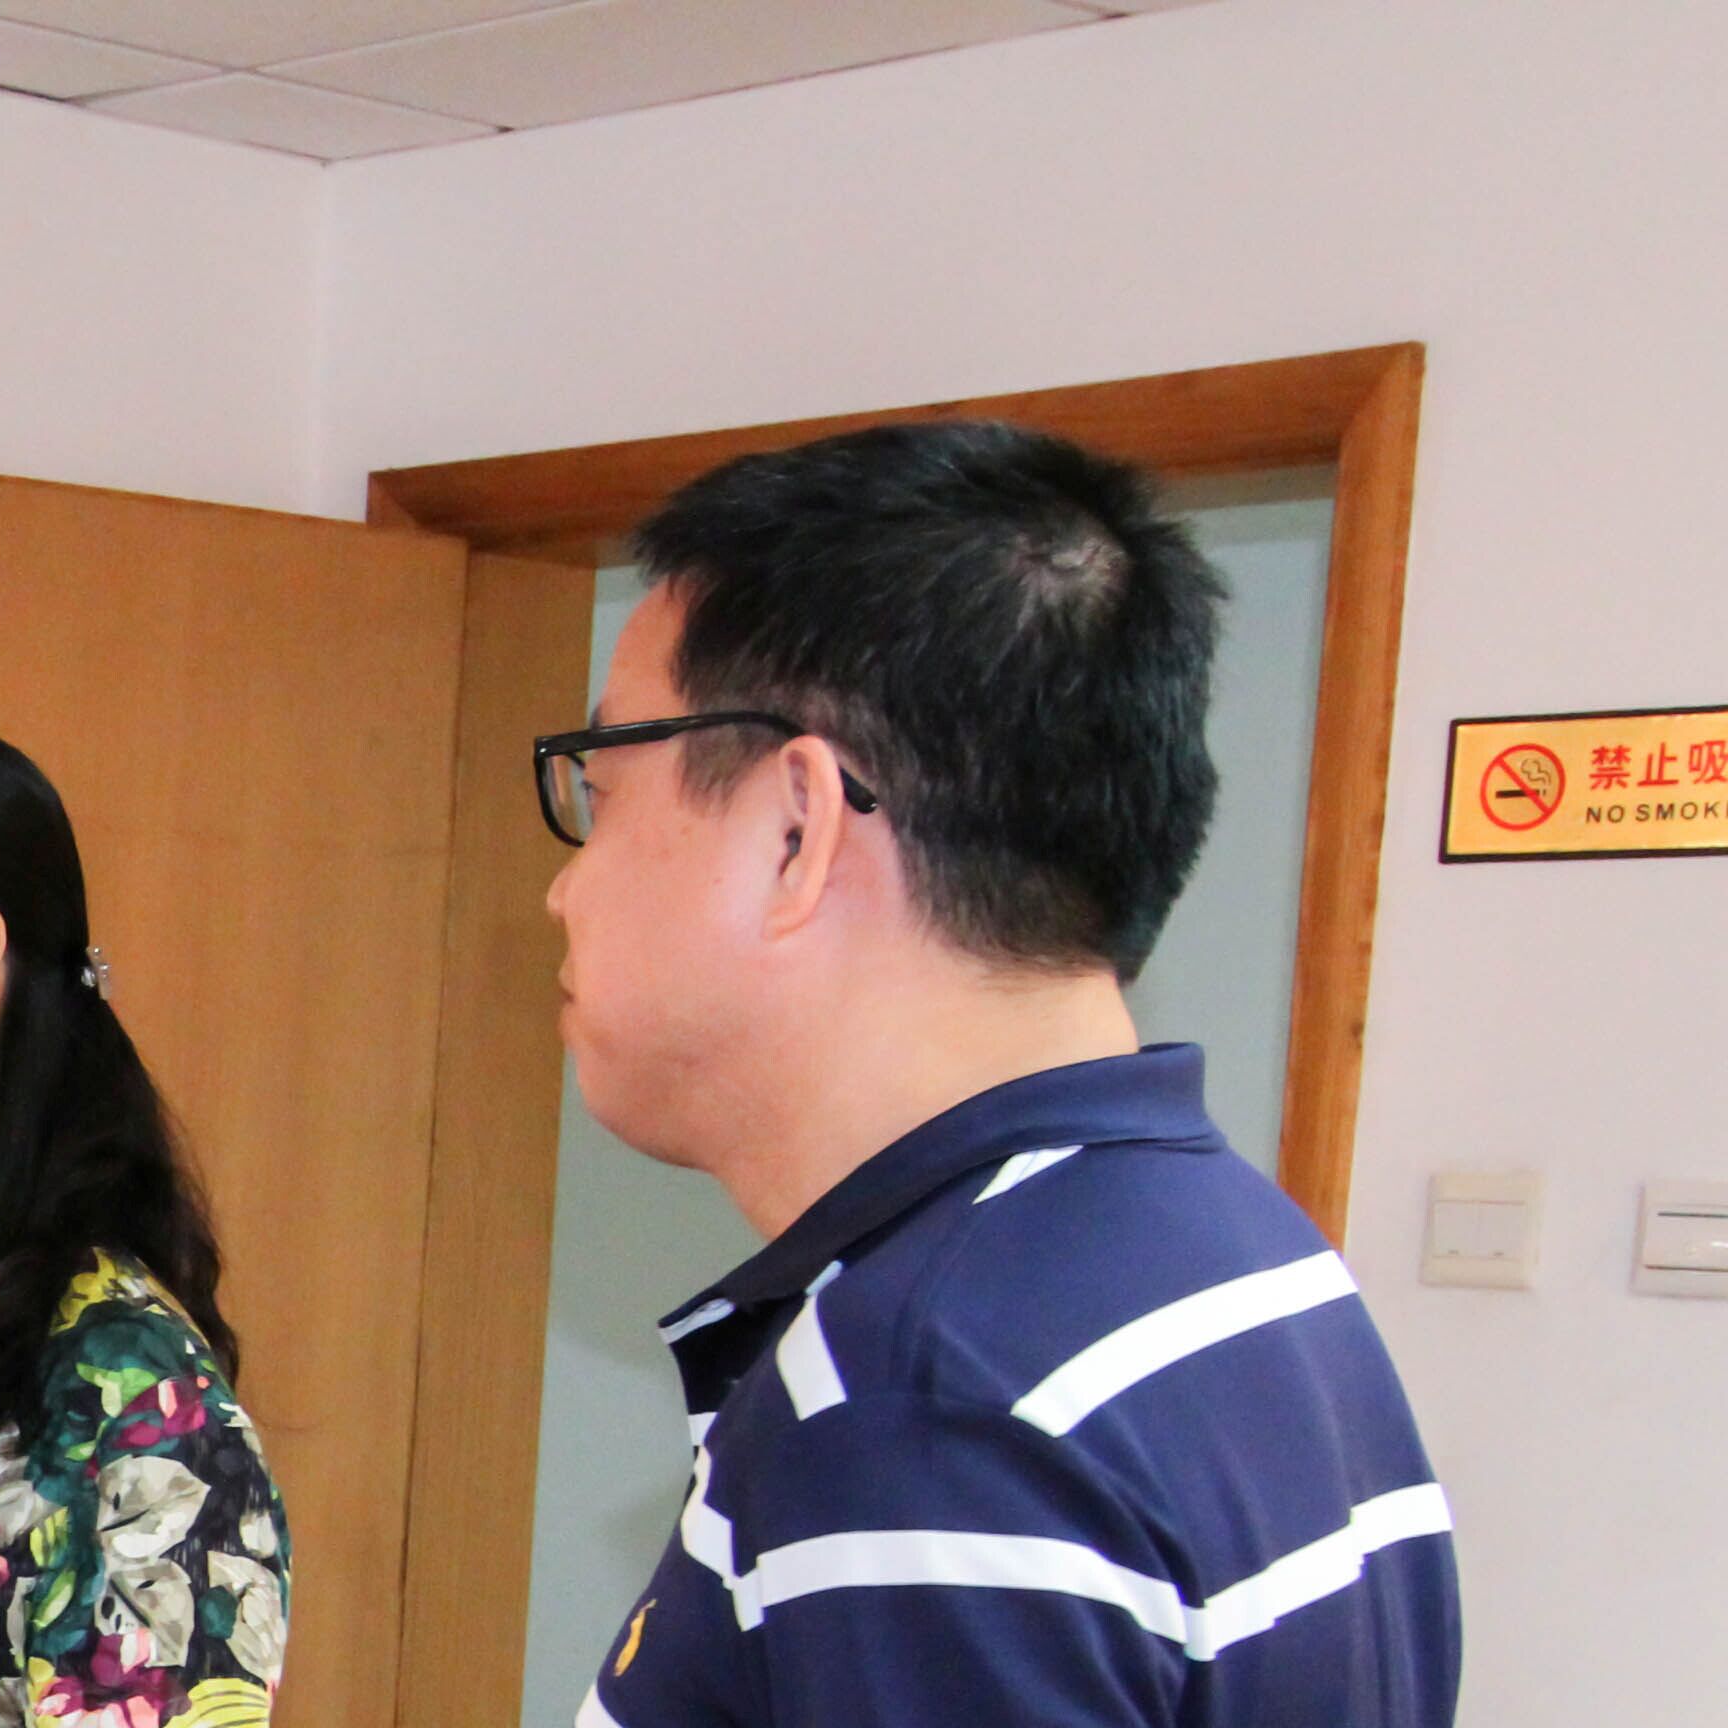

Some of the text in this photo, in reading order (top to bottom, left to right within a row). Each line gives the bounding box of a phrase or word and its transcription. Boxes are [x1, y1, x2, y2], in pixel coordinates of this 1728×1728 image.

[1588, 740, 1728, 791] 禁止吸
[1585, 804, 1626, 824] NO
